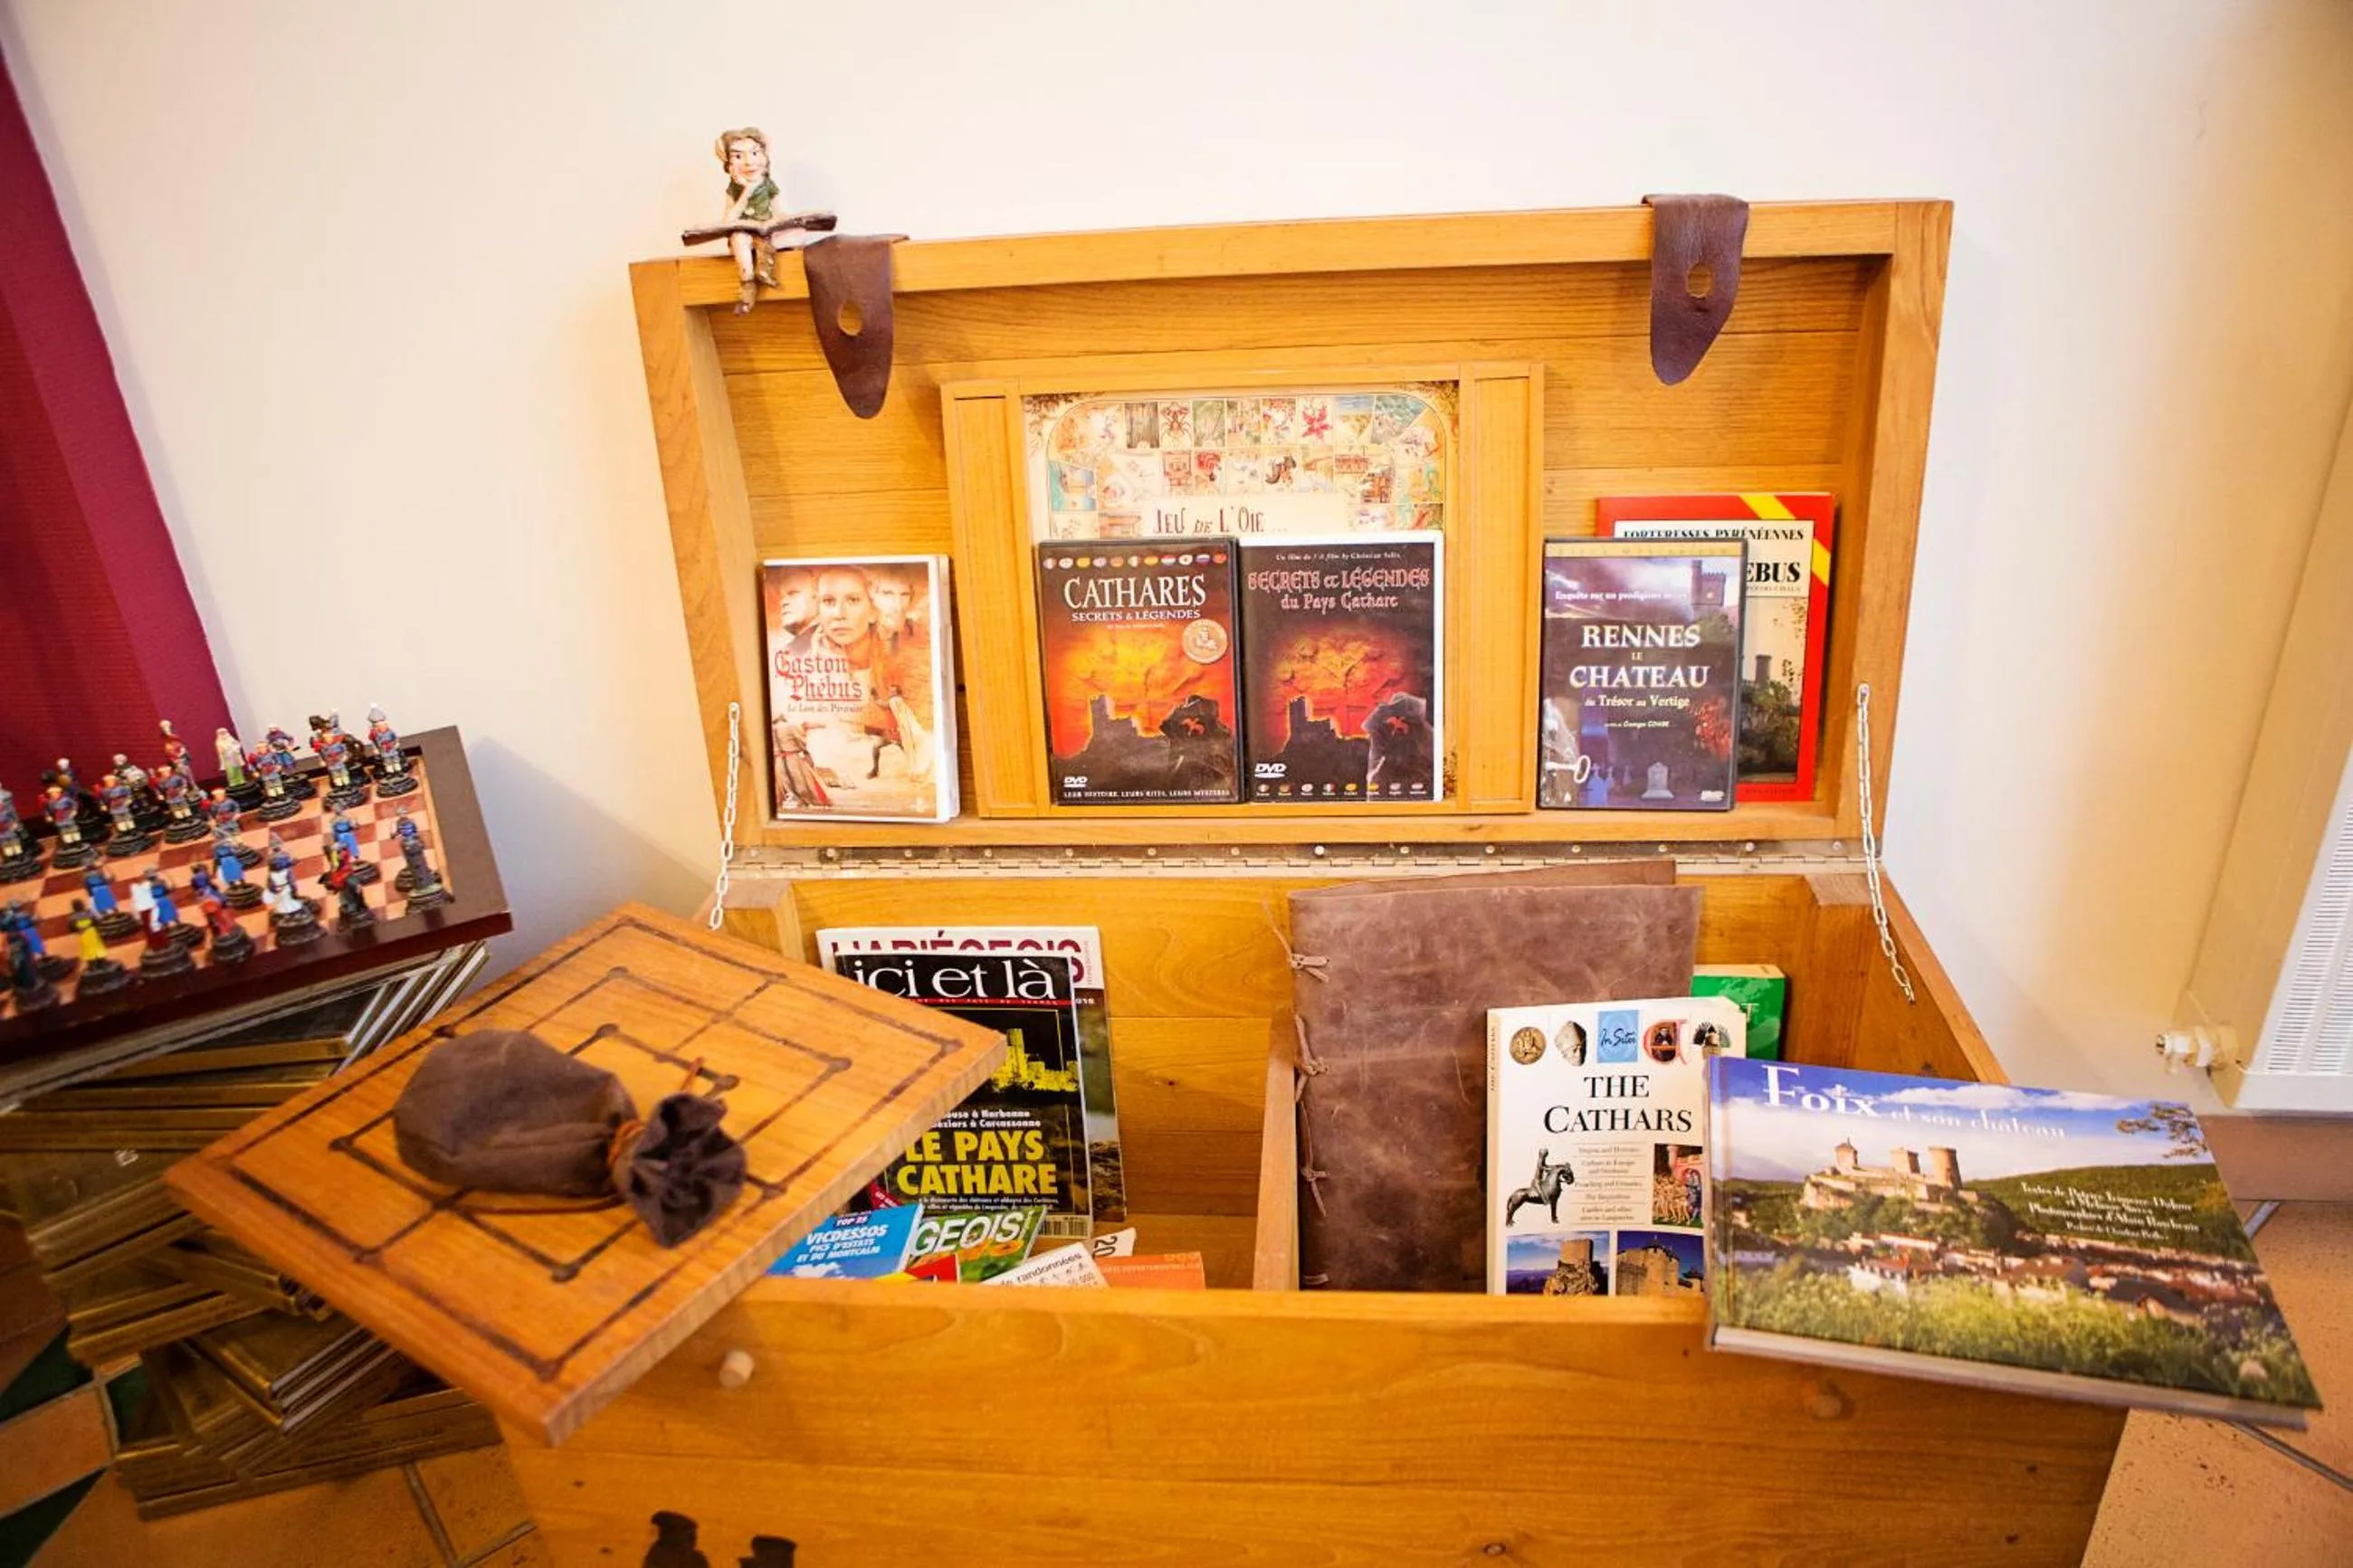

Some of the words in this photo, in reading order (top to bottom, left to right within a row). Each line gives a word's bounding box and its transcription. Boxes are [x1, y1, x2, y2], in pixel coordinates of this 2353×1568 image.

[1155, 507, 1186, 534] JEU
[1063, 574, 1206, 609] CATHARES
[1247, 568, 1320, 594] SECRETS
[1281, 594, 1300, 609] du
[1303, 594, 1336, 615] Pays
[1340, 591, 1399, 612] Cathare
[1072, 611, 1122, 622] SECRETS
[1126, 612, 1132, 620] &
[1581, 623, 1701, 649] RENNES
[775, 650, 846, 679] Gaston
[1631, 651, 1643, 661] LE
[1569, 665, 1710, 689] CHATEAU
[1597, 695, 1634, 707] Trésor
[1649, 694, 1691, 709] Vertige
[1063, 775, 1087, 784] DVD
[1254, 763, 1287, 773] DVD
[853, 959, 919, 998] ici
[931, 963, 989, 998] et
[1001, 958, 1056, 1000] là
[1584, 1075, 1649, 1098] THE
[1761, 1063, 1881, 1118] Foix
[1891, 1105, 1911, 1122] et
[979, 1119, 1042, 1128] Carcassonne
[981, 1109, 1031, 1118] Narbonne
[1544, 1105, 1692, 1134] CATHARS
[906, 1131, 942, 1162] LE
[954, 1130, 1044, 1161] PAYS
[897, 1164, 1058, 1195] CATHARE
[836, 1217, 855, 1226] TOP
[855, 1215, 869, 1224] 25
[806, 1224, 889, 1245] VICDESSOS
[911, 1212, 1024, 1256] GEOIS
